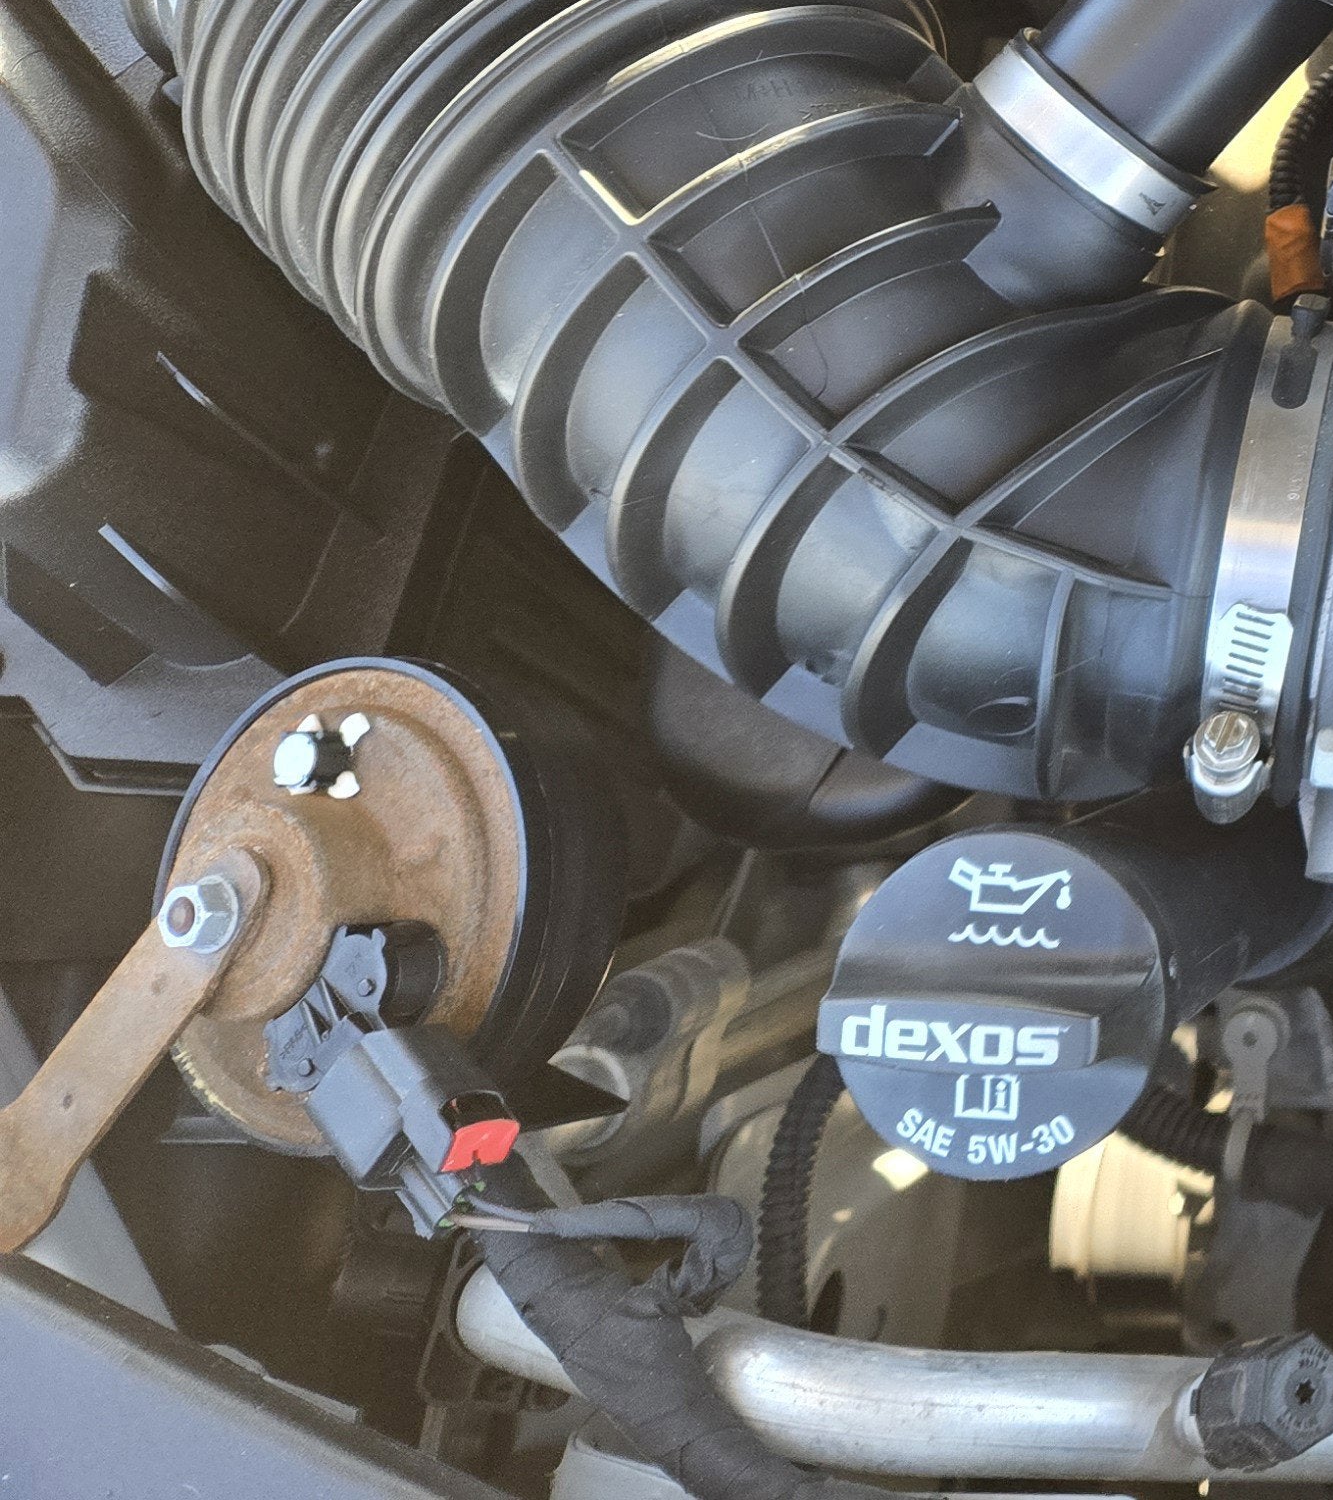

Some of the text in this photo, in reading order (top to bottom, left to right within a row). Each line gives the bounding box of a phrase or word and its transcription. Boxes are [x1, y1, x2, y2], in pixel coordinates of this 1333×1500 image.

[840, 1004, 1060, 1066] dexos
[896, 1107, 1076, 1165] SAE 5W-30
